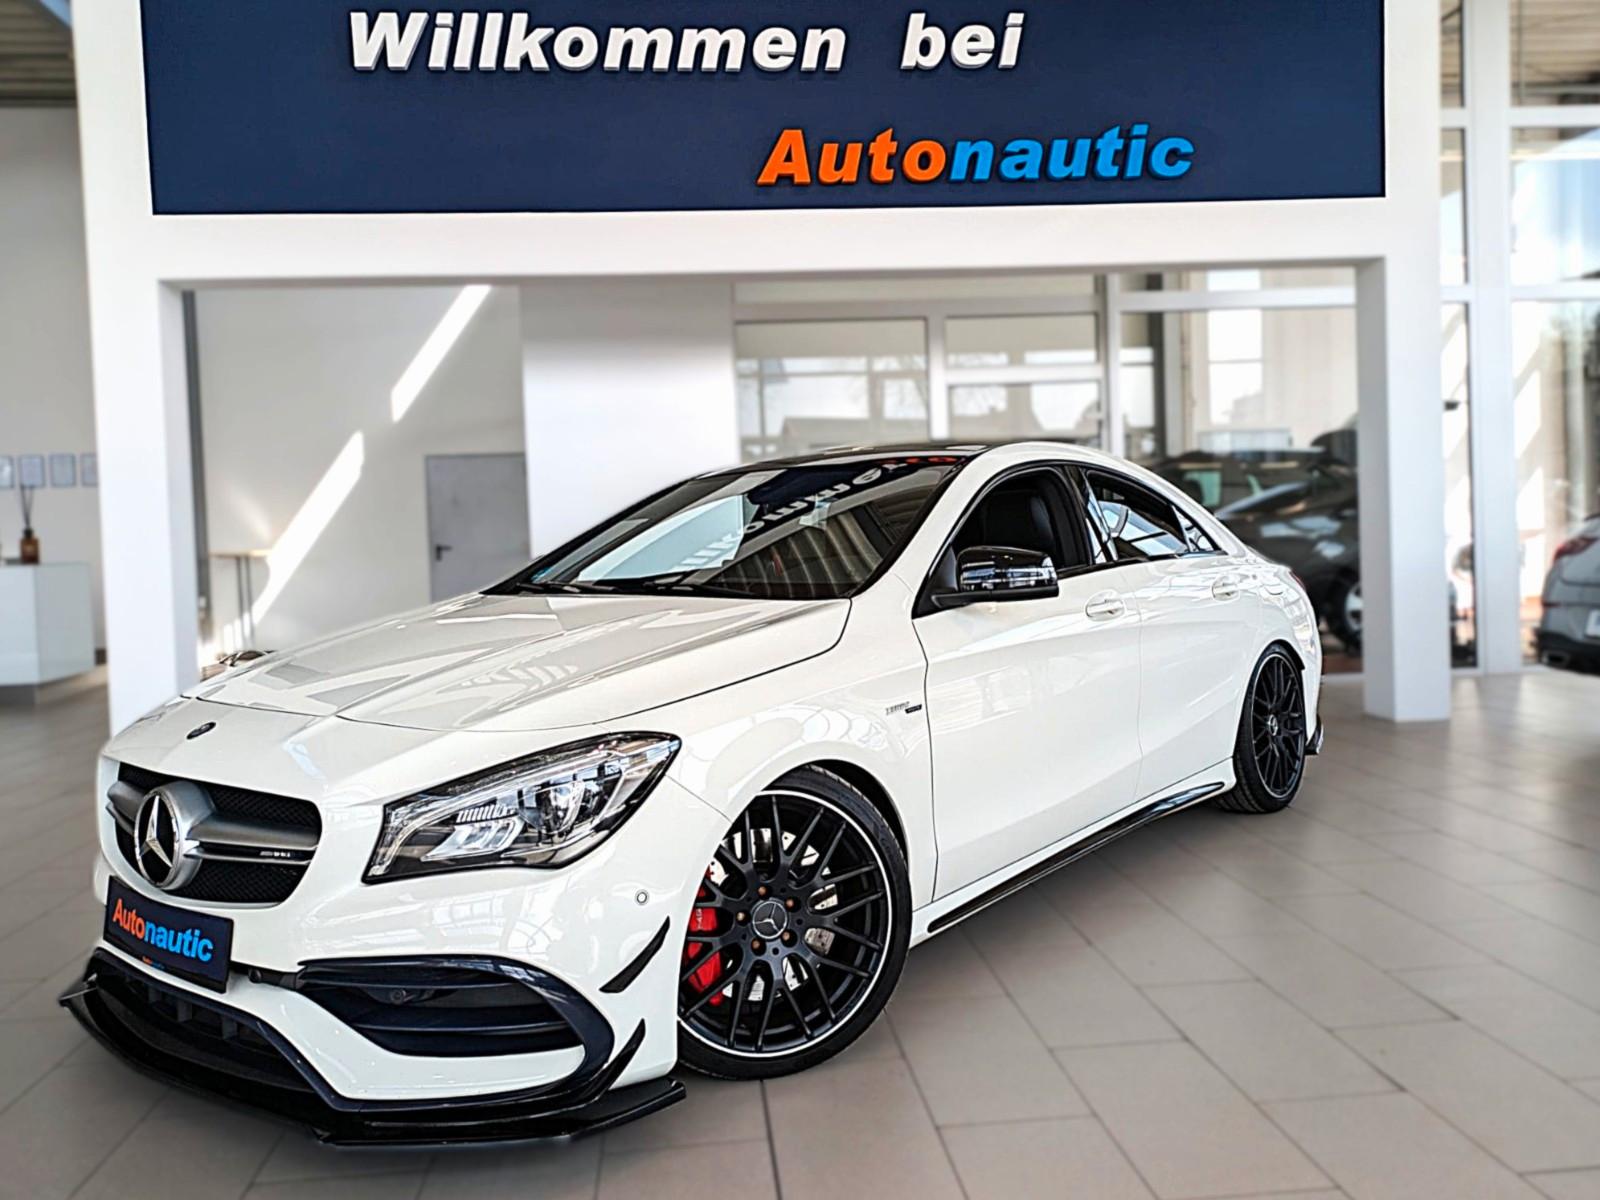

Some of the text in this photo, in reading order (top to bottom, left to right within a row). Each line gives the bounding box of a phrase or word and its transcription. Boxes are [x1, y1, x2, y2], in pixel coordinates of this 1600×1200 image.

[350, 12, 1025, 71] Willkommen bei
[757, 124, 1195, 185] Autonautic
[112, 898, 214, 962] Autonautic
